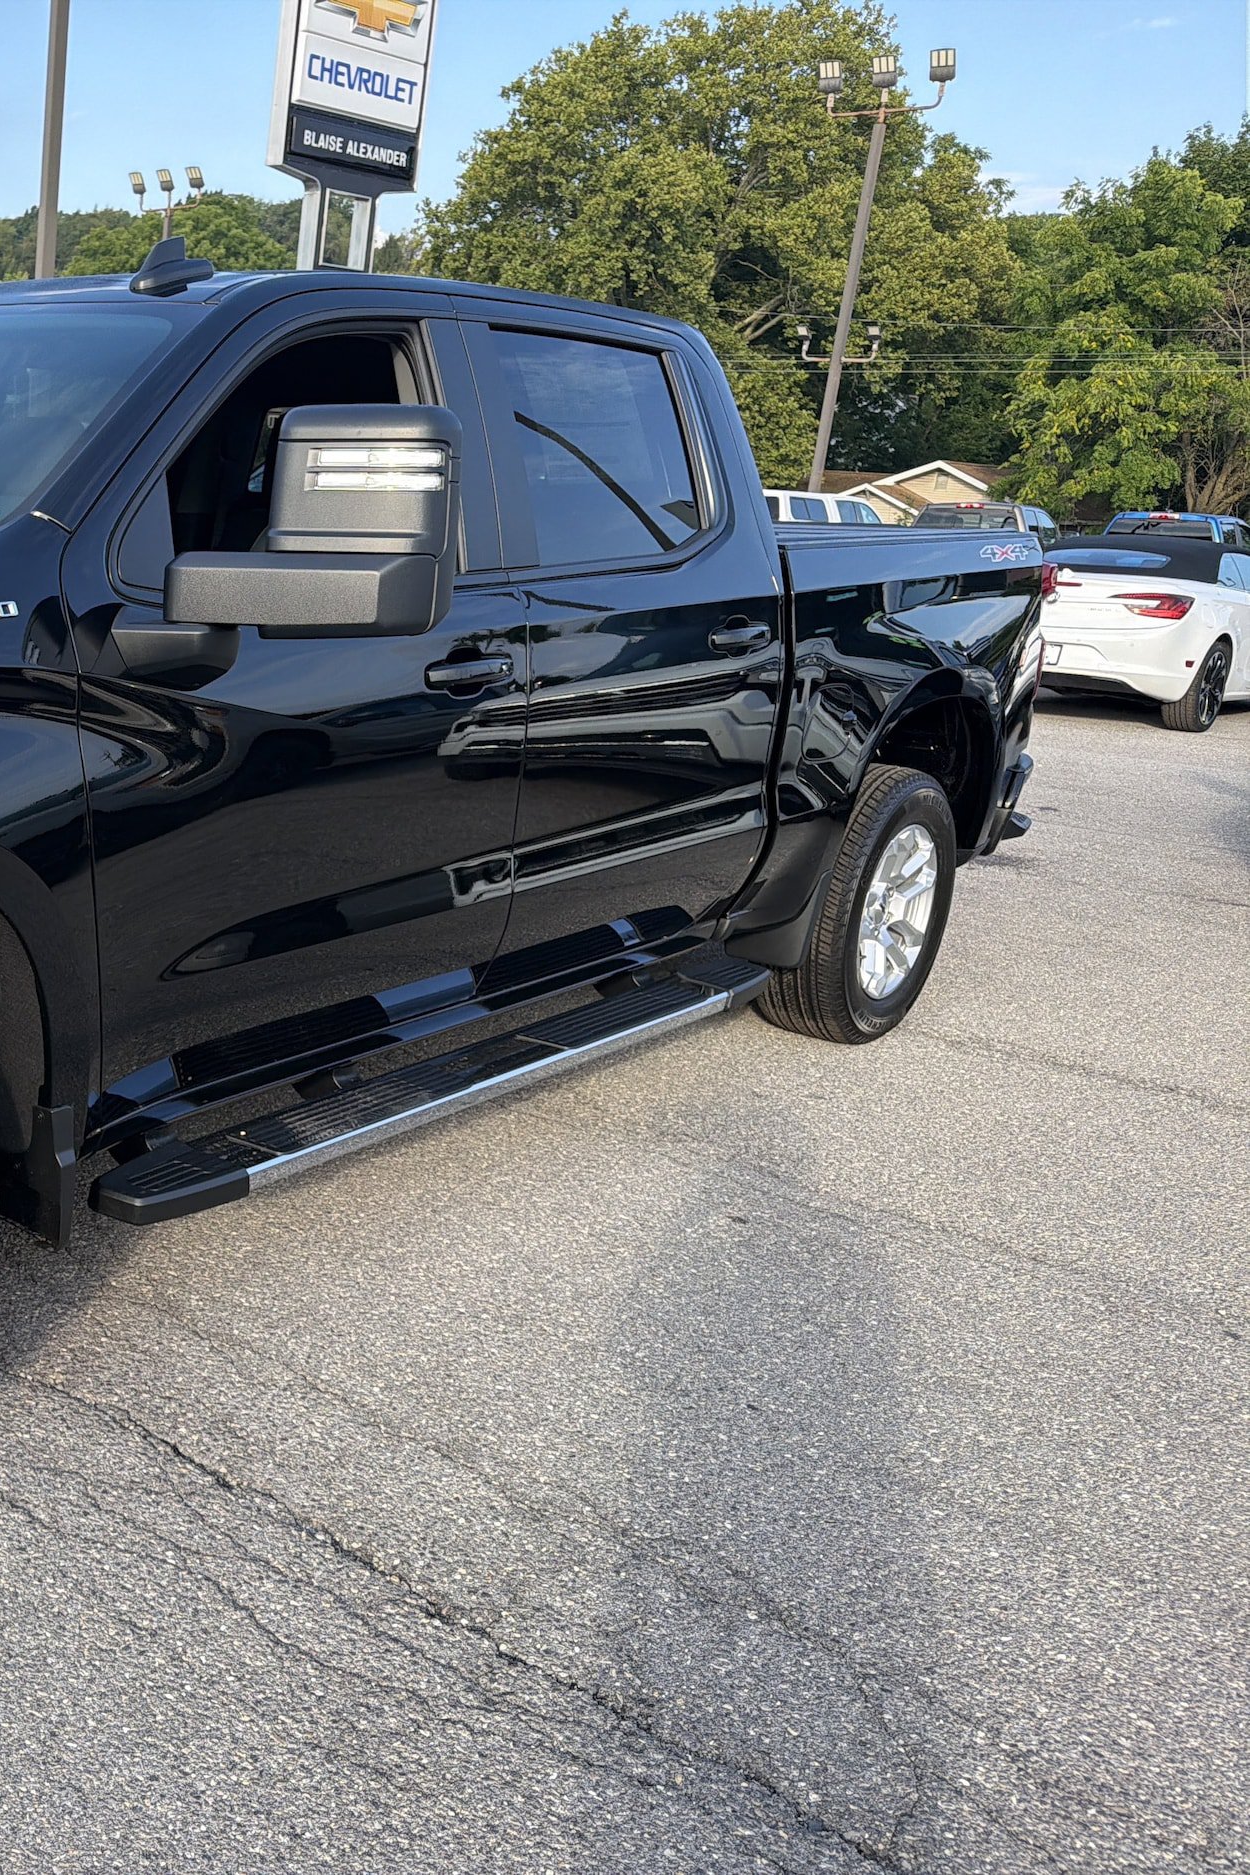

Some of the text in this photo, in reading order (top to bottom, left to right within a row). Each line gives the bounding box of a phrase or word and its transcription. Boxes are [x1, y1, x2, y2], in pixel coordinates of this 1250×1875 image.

[307, 53, 418, 105] CHEVROLET
[303, 129, 408, 167] BLAISE ALEXANDER
